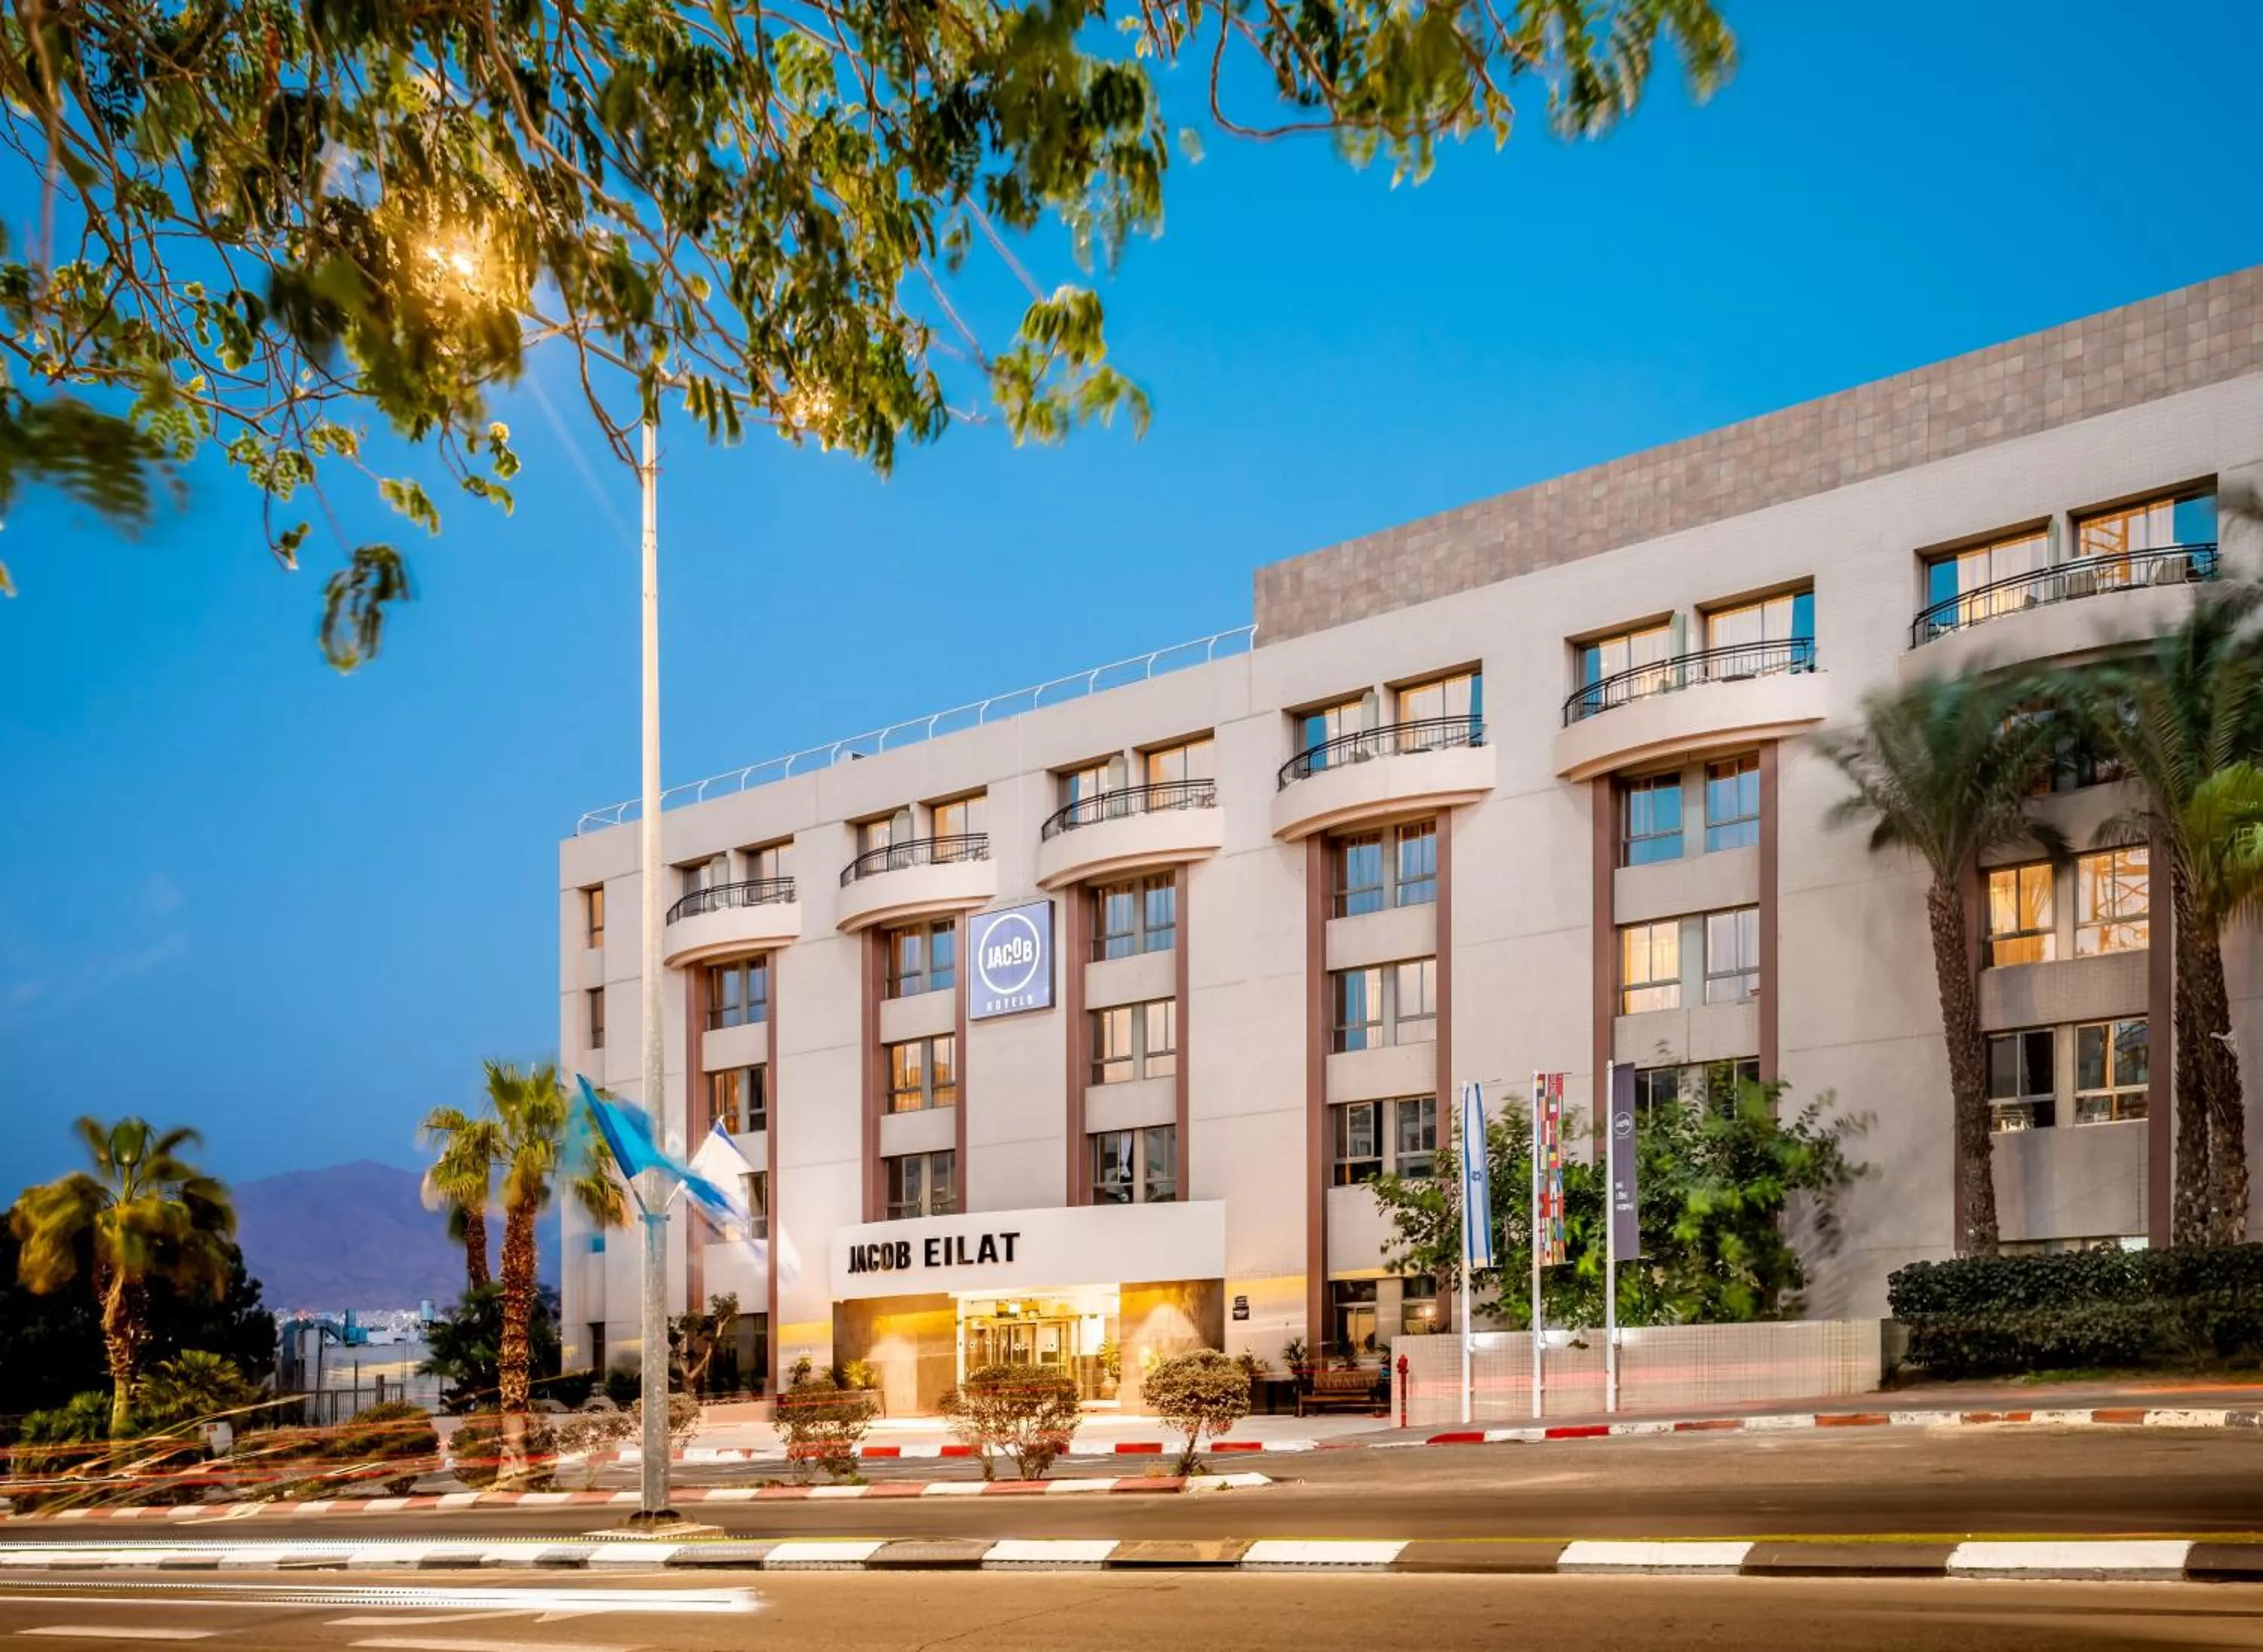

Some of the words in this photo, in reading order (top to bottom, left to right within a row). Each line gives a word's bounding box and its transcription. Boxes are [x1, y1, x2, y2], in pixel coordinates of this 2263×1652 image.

[987, 936, 1033, 969] JACOB
[987, 994, 1033, 1012] HOTELS
[847, 1241, 911, 1273] JACOB
[924, 1232, 1020, 1268] EILAT
